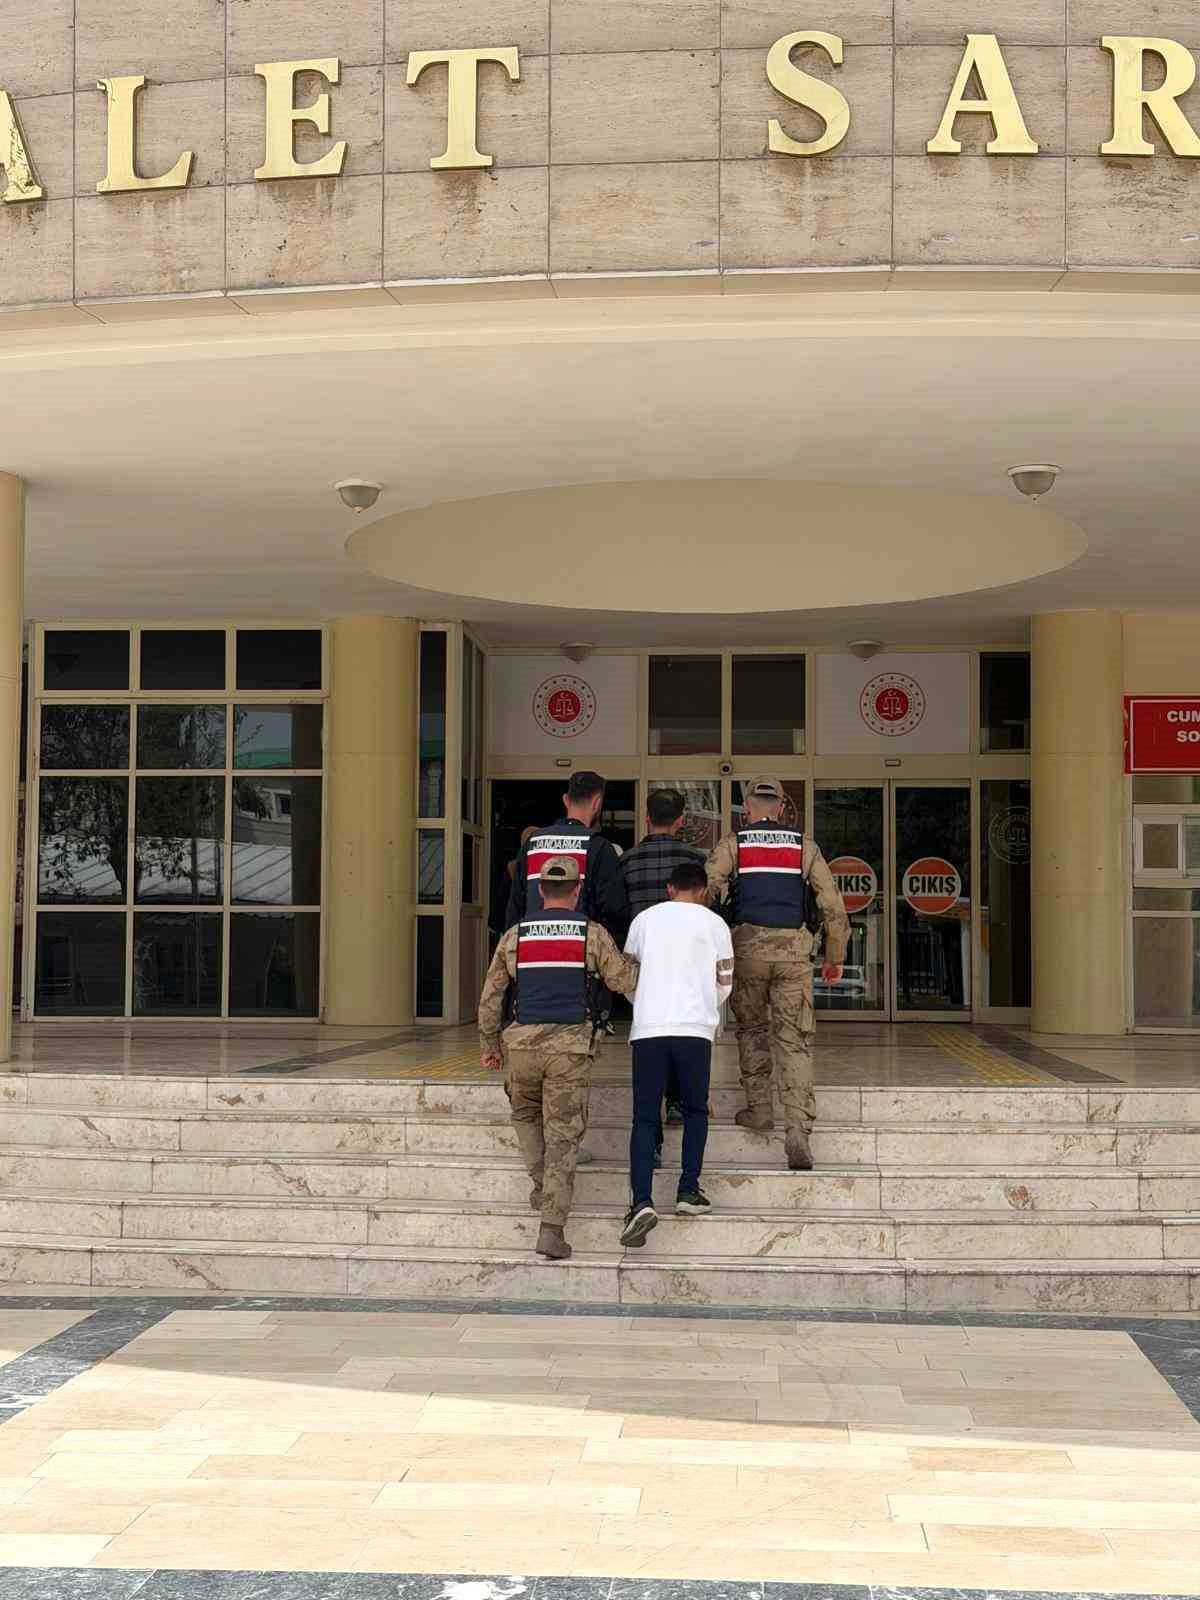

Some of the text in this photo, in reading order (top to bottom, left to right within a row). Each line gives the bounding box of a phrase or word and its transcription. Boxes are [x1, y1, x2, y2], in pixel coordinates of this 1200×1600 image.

[766, 30, 1200, 157] SAR
[533, 839, 582, 850] JANDARMA
[745, 832, 796, 844] JANDARMA
[832, 875, 872, 895] IKIŞ
[909, 876, 956, 896] ÇIKIŞ
[526, 924, 581, 937] JANDARMA
